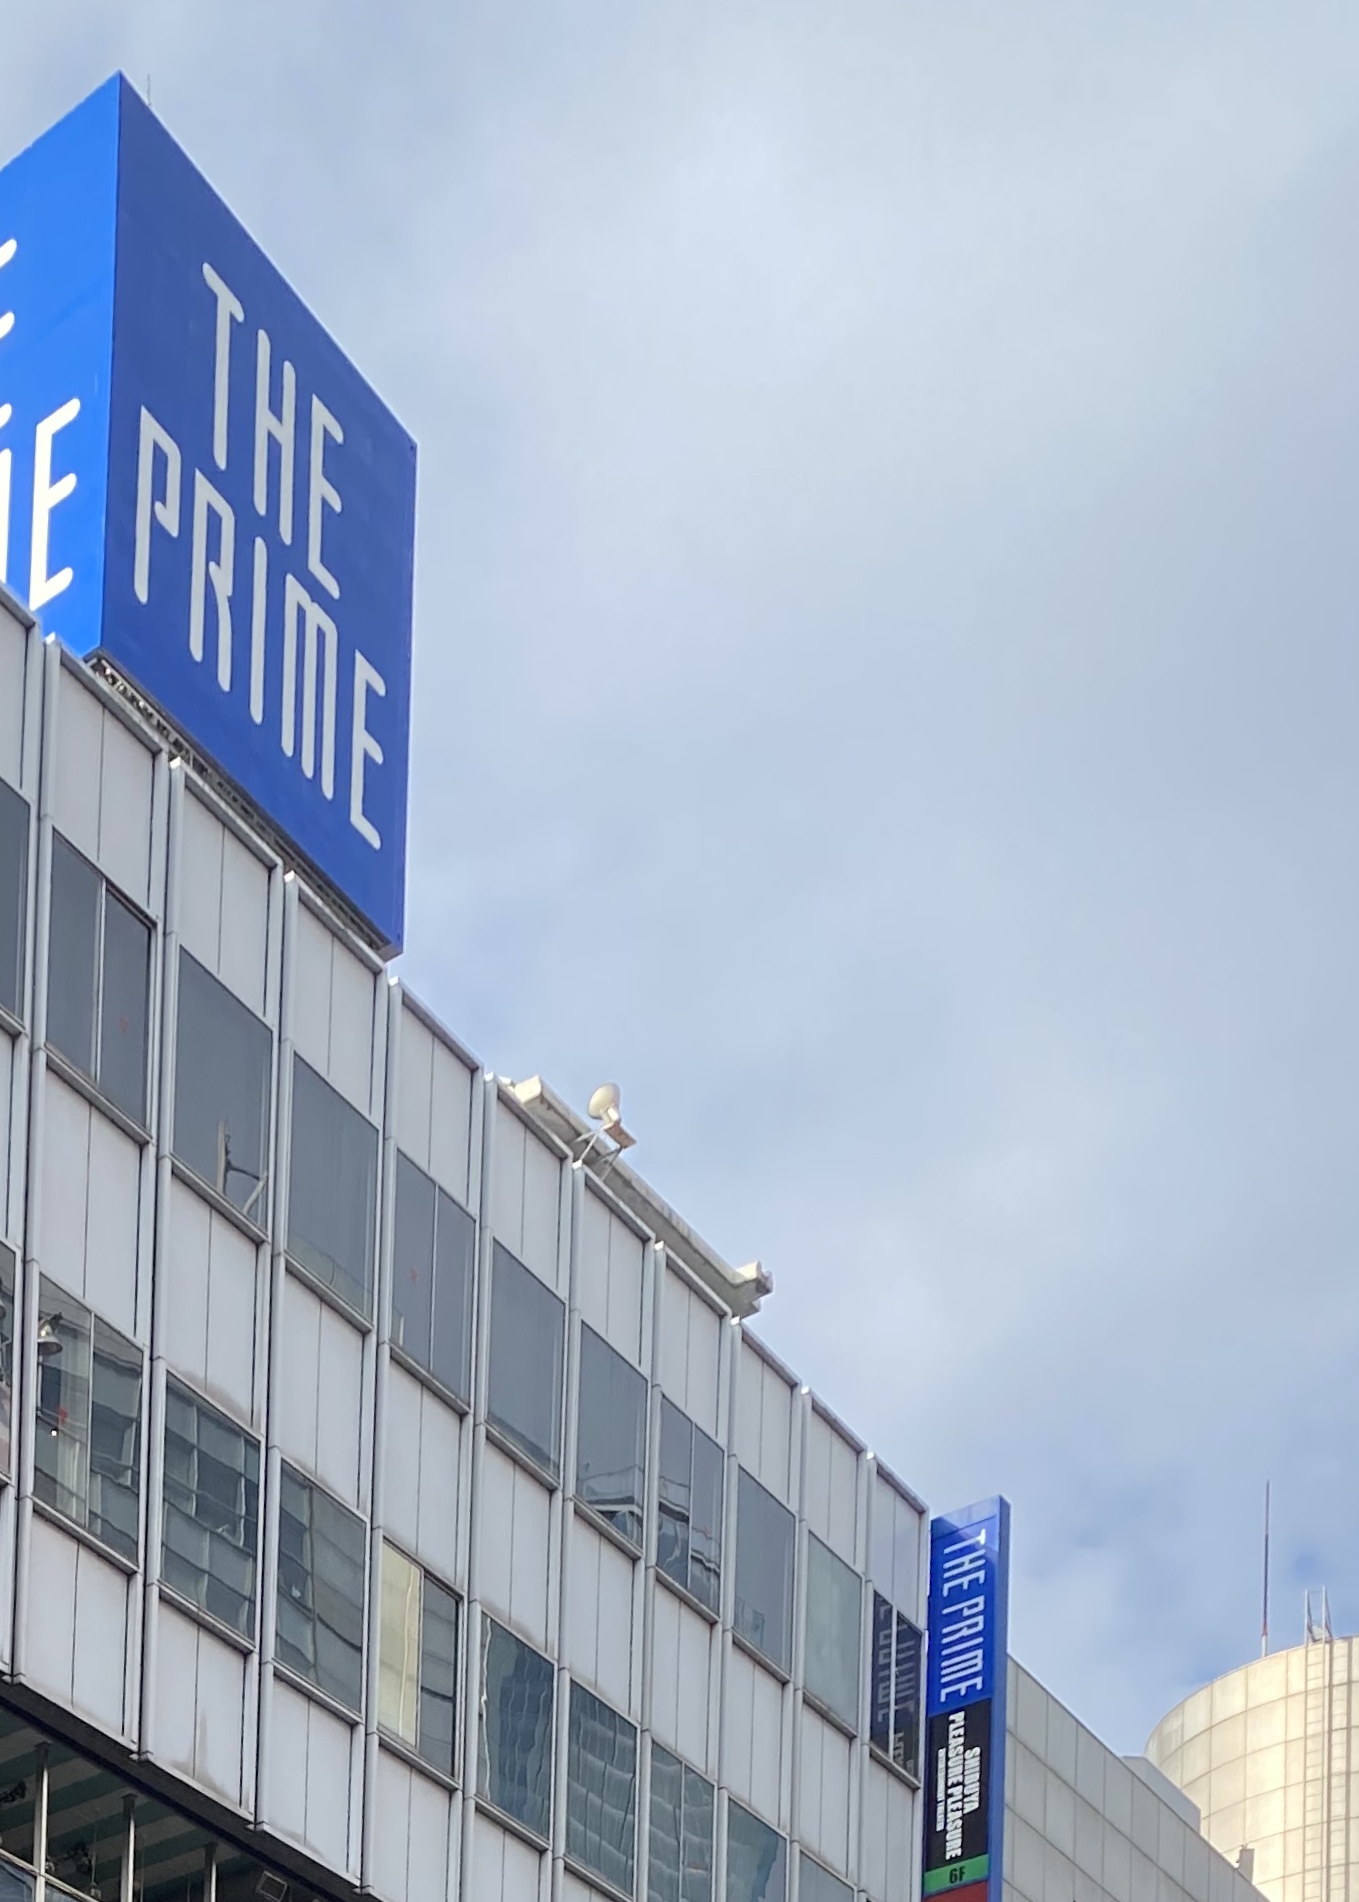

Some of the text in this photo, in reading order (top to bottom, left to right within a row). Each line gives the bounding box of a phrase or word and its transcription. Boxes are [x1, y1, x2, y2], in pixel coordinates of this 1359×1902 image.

[202, 262, 345, 600] THE
[133, 404, 387, 852] PRIME
[939, 1528, 986, 1703] THE PRIME
[945, 1710, 966, 1861] PLEASURE PLEASURE
[948, 1865, 966, 1885] 6F
